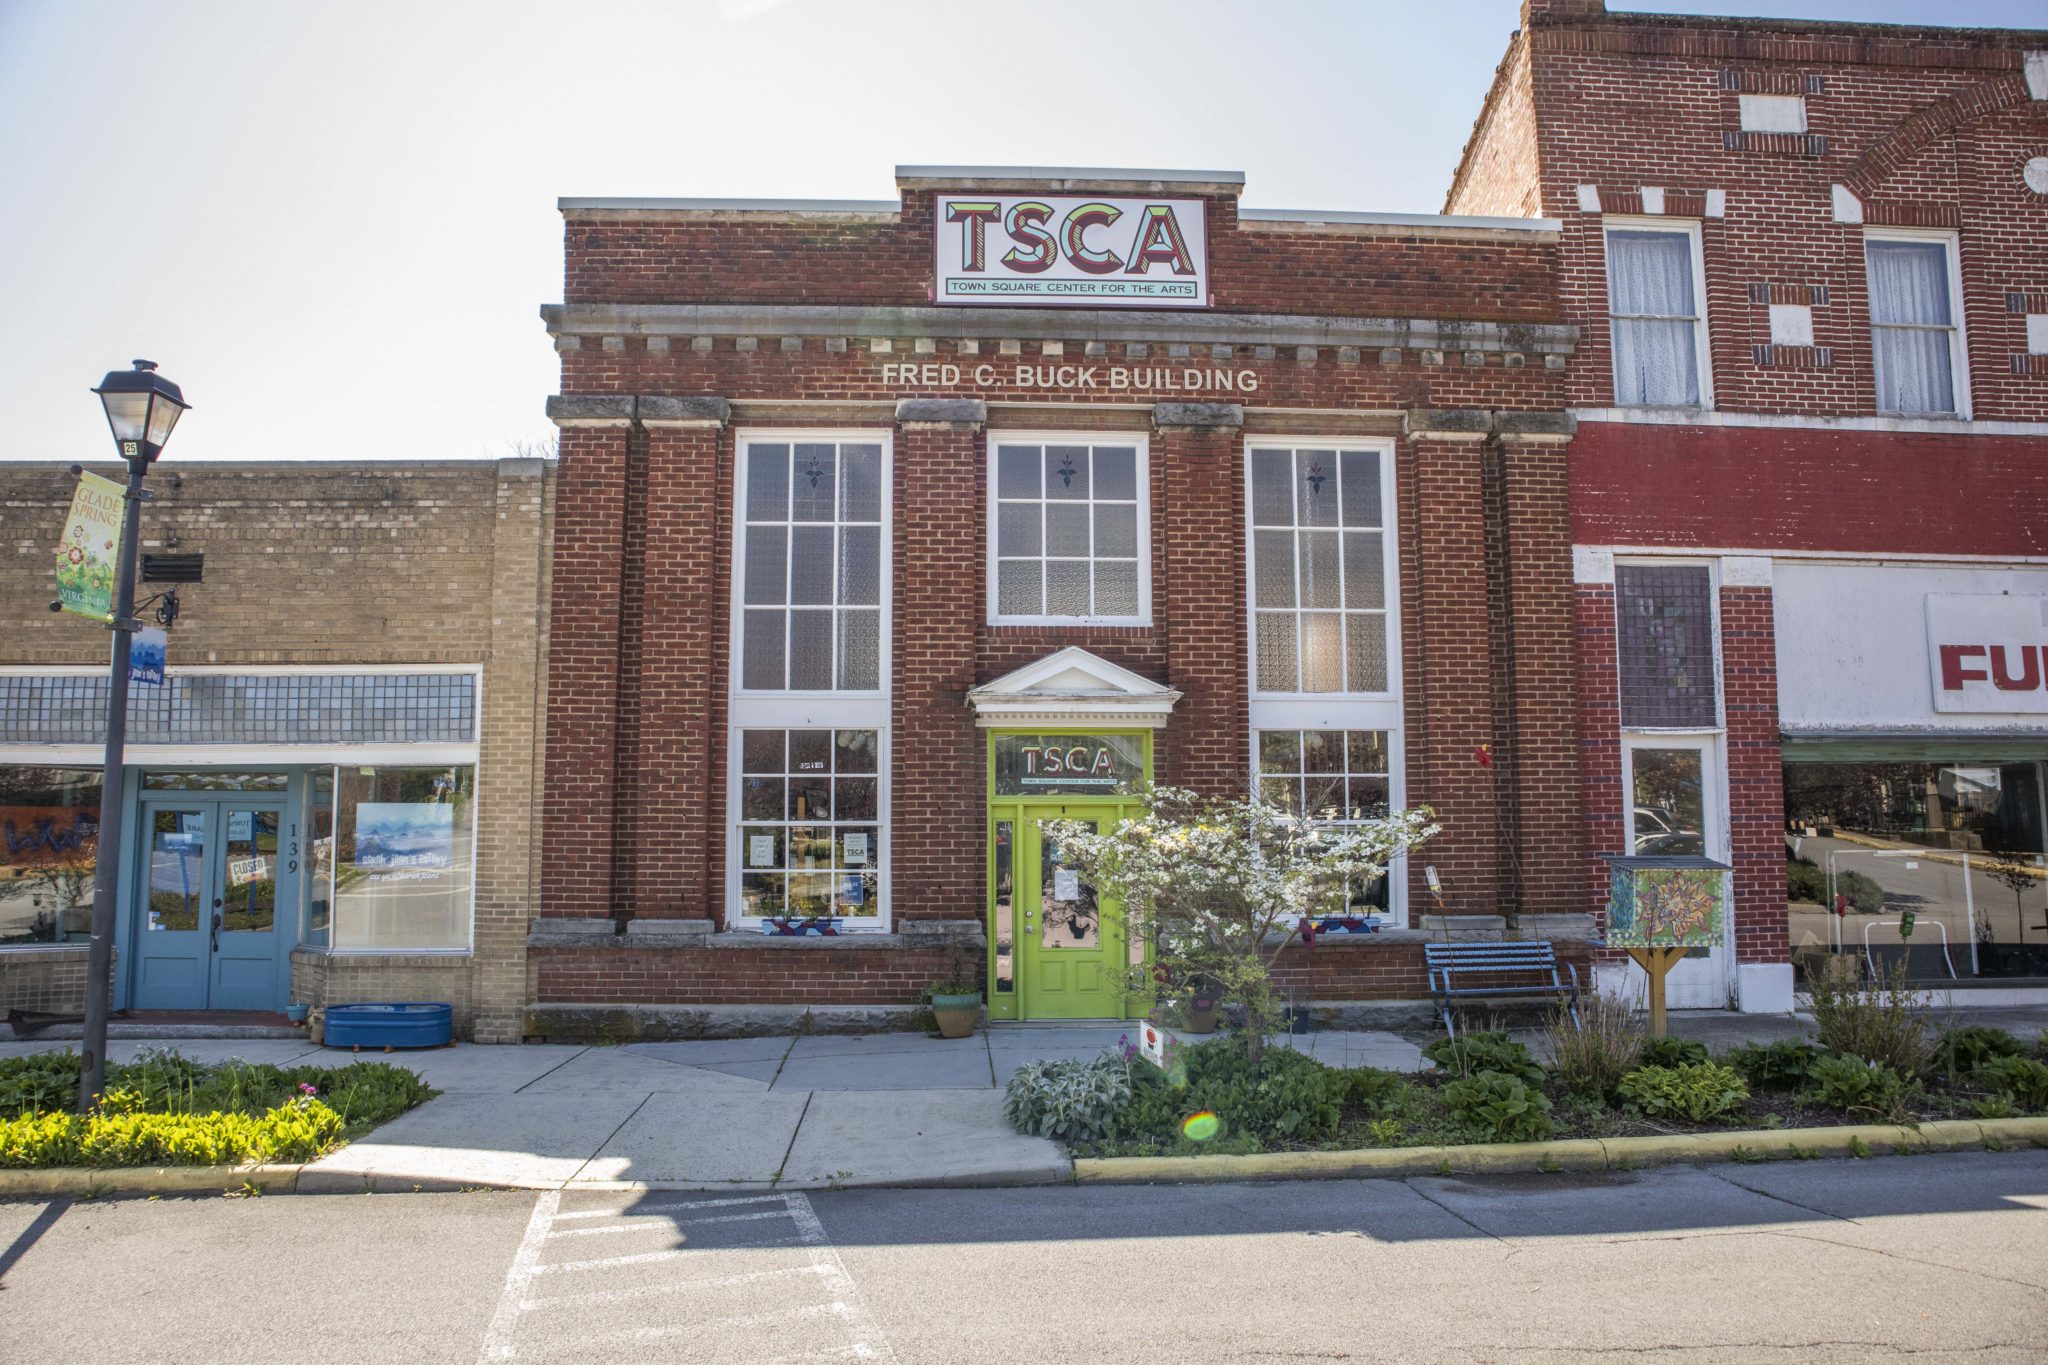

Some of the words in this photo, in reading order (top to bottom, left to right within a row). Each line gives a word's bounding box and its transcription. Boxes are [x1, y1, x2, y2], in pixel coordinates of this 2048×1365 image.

[946, 201, 1197, 276] TSCA
[951, 282, 986, 291] TOWN
[992, 282, 1041, 292] SQUARE
[1047, 283, 1096, 293] CENTER
[1101, 284, 1126, 293] FOR
[1131, 285, 1155, 293] THE
[1160, 285, 1193, 294] ARTS
[882, 363, 961, 387] FRED
[974, 364, 1002, 388] C.
[1015, 365, 1098, 389] BUCK
[1110, 366, 1258, 392] BUILDING
[125, 444, 136, 453] 25
[77, 487, 121, 513] GLADE
[72, 501, 118, 527] SPRING
[60, 588, 107, 608] VIRGINIA
[1021, 746, 1118, 776] TSCA
[288, 823, 298, 873] 139
[232, 859, 264, 876] CLOSED
